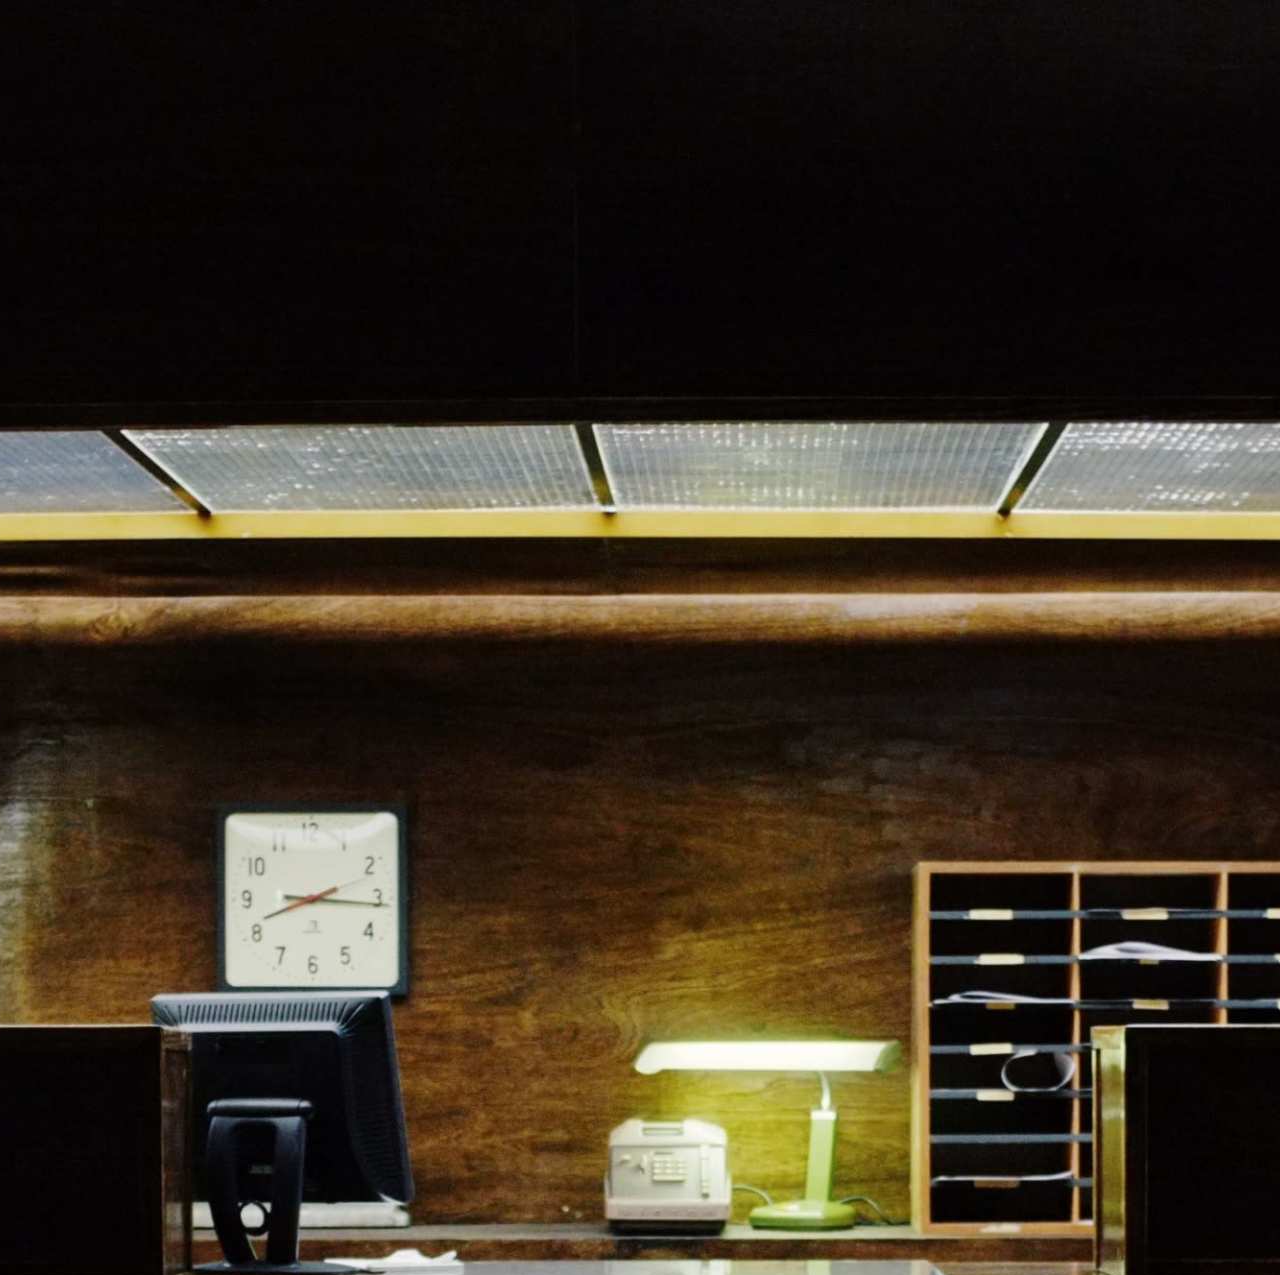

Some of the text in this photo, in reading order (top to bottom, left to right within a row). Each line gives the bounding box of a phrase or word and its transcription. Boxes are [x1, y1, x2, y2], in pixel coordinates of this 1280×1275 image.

[272, 832, 287, 852] 11
[301, 822, 320, 843] 12
[247, 856, 266, 877] 10
[365, 856, 375, 876] 2
[240, 889, 253, 910] 9
[372, 887, 384, 908] 3
[251, 923, 263, 943] 8
[362, 921, 375, 941] 4
[274, 946, 287, 966] 7
[307, 955, 319, 975] 6
[339, 945, 351, 966] 5
